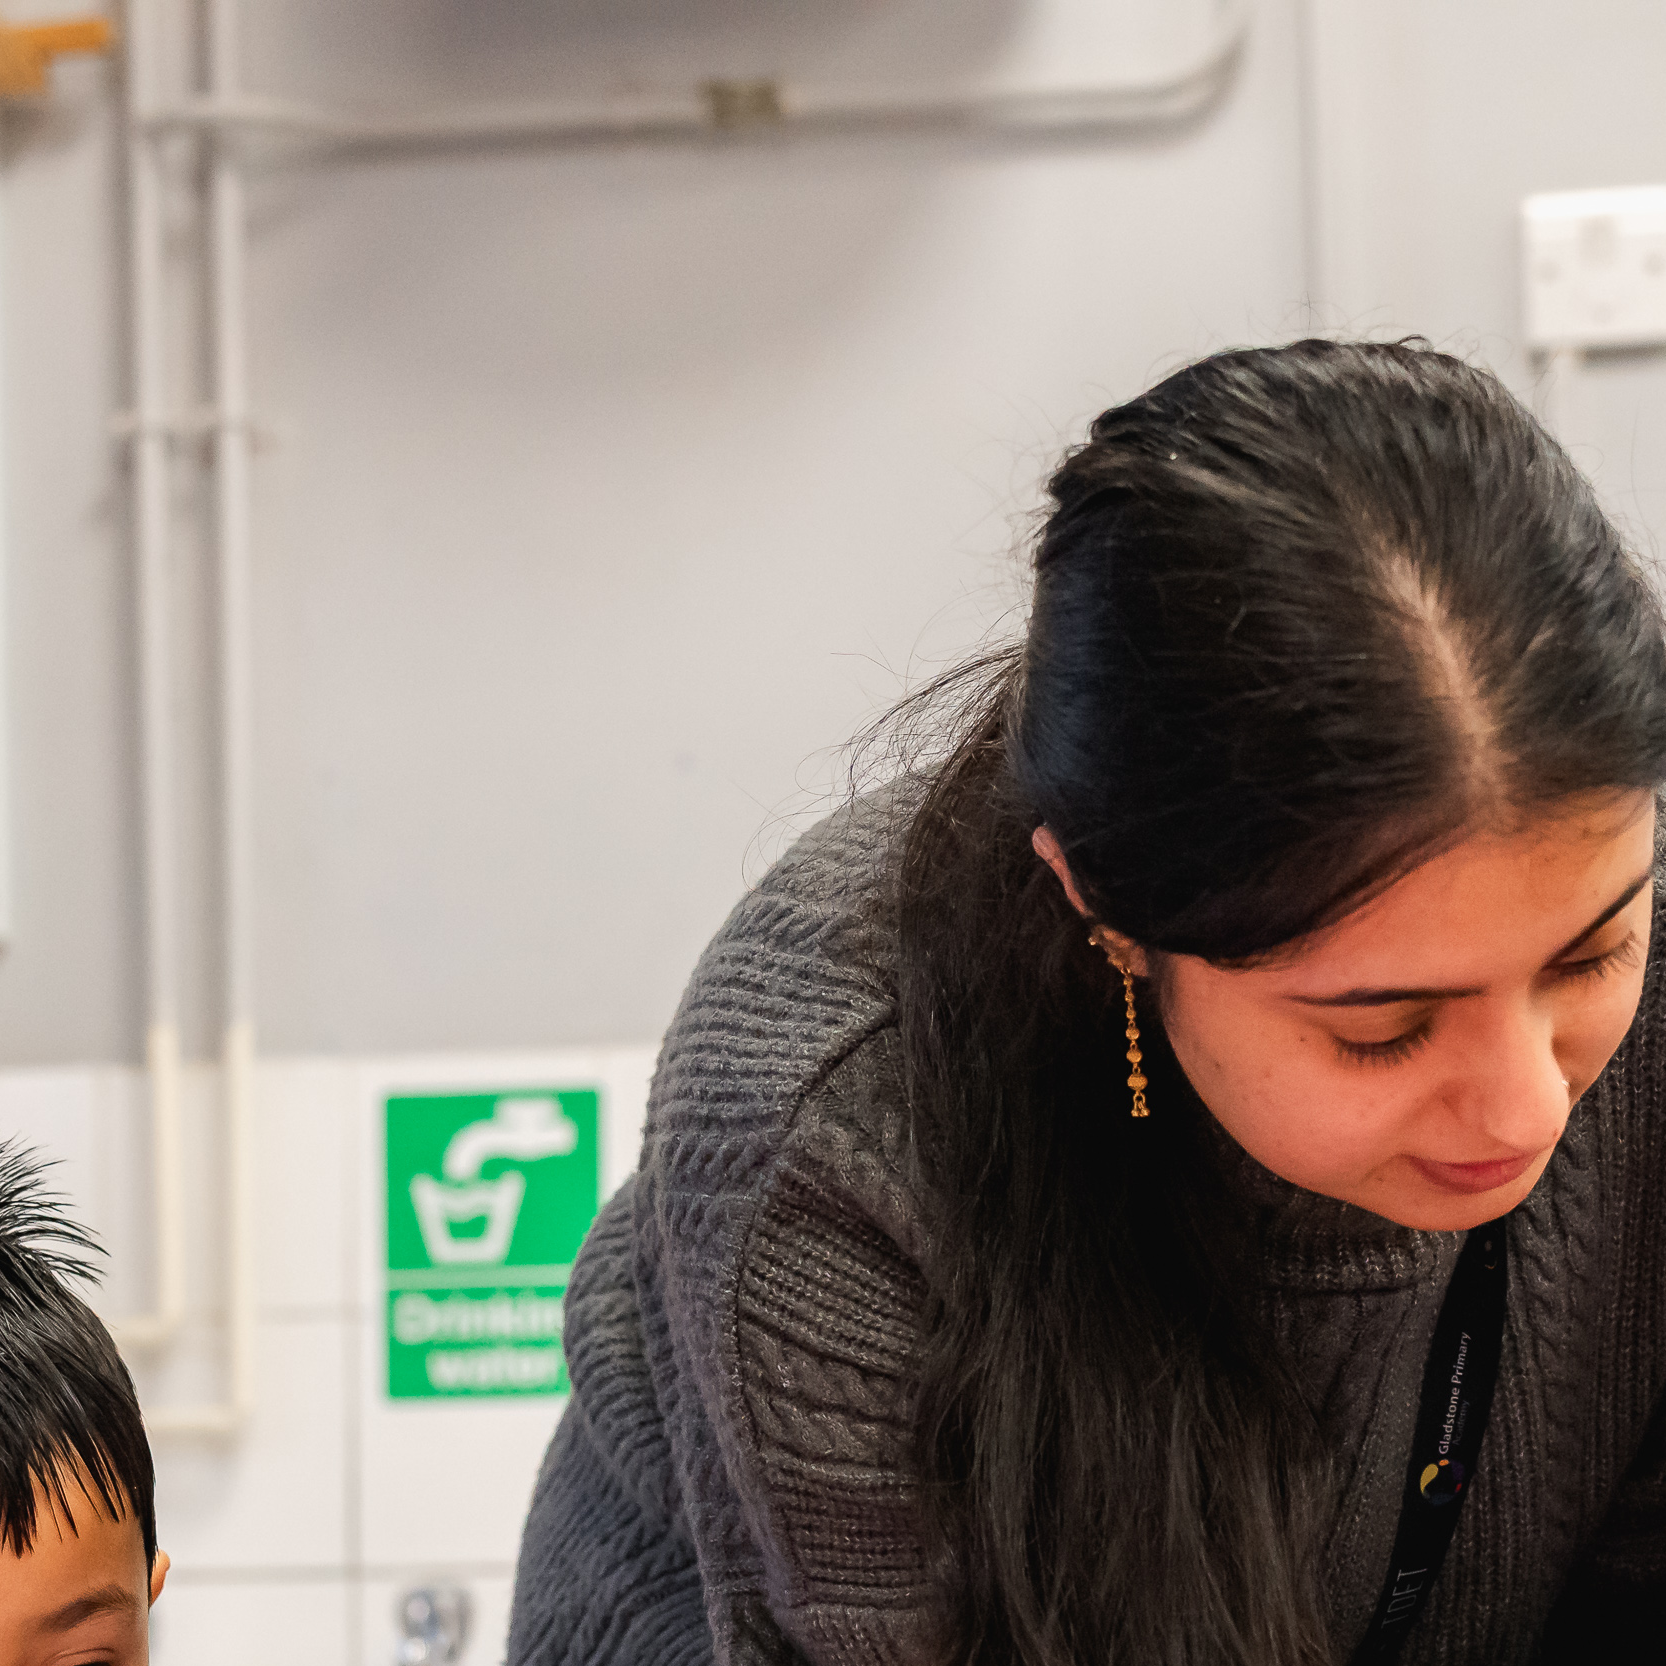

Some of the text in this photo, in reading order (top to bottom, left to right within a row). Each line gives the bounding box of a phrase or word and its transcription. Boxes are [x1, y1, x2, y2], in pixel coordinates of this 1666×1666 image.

[395, 1291, 566, 1345] Drinkin
[1438, 1331, 1473, 1455] Gladstone Primary
